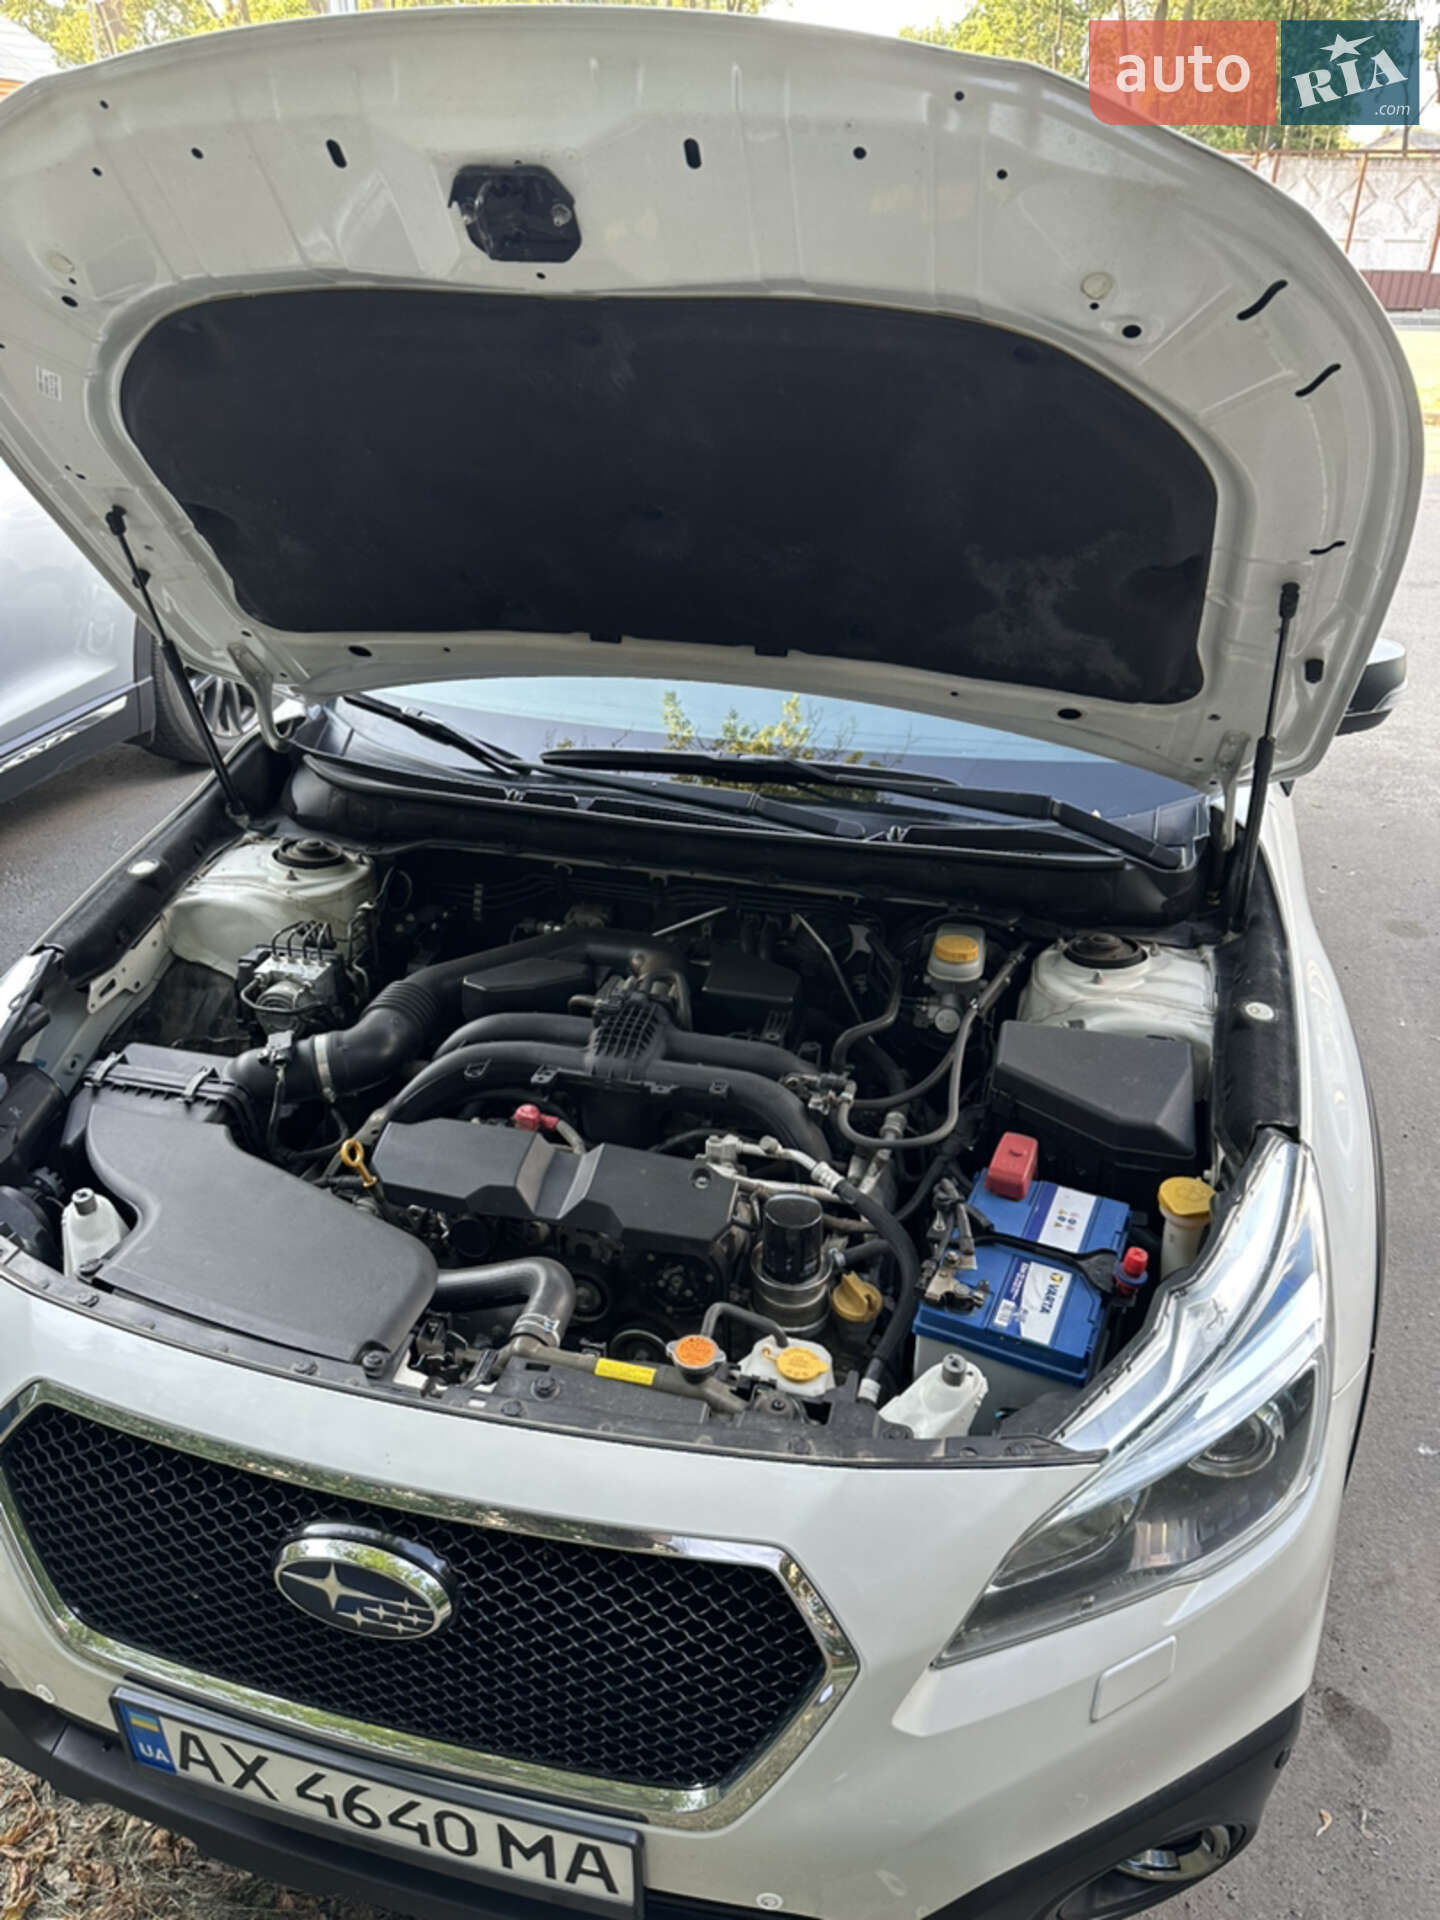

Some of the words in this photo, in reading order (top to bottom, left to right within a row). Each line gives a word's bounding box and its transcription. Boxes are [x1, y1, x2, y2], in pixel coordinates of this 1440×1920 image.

[1040, 1284, 1059, 1314] VARTA
[138, 1742, 170, 1765] UA
[179, 1731, 280, 1802] AX
[296, 1773, 478, 1857] 4640
[497, 1824, 619, 1894] MA
